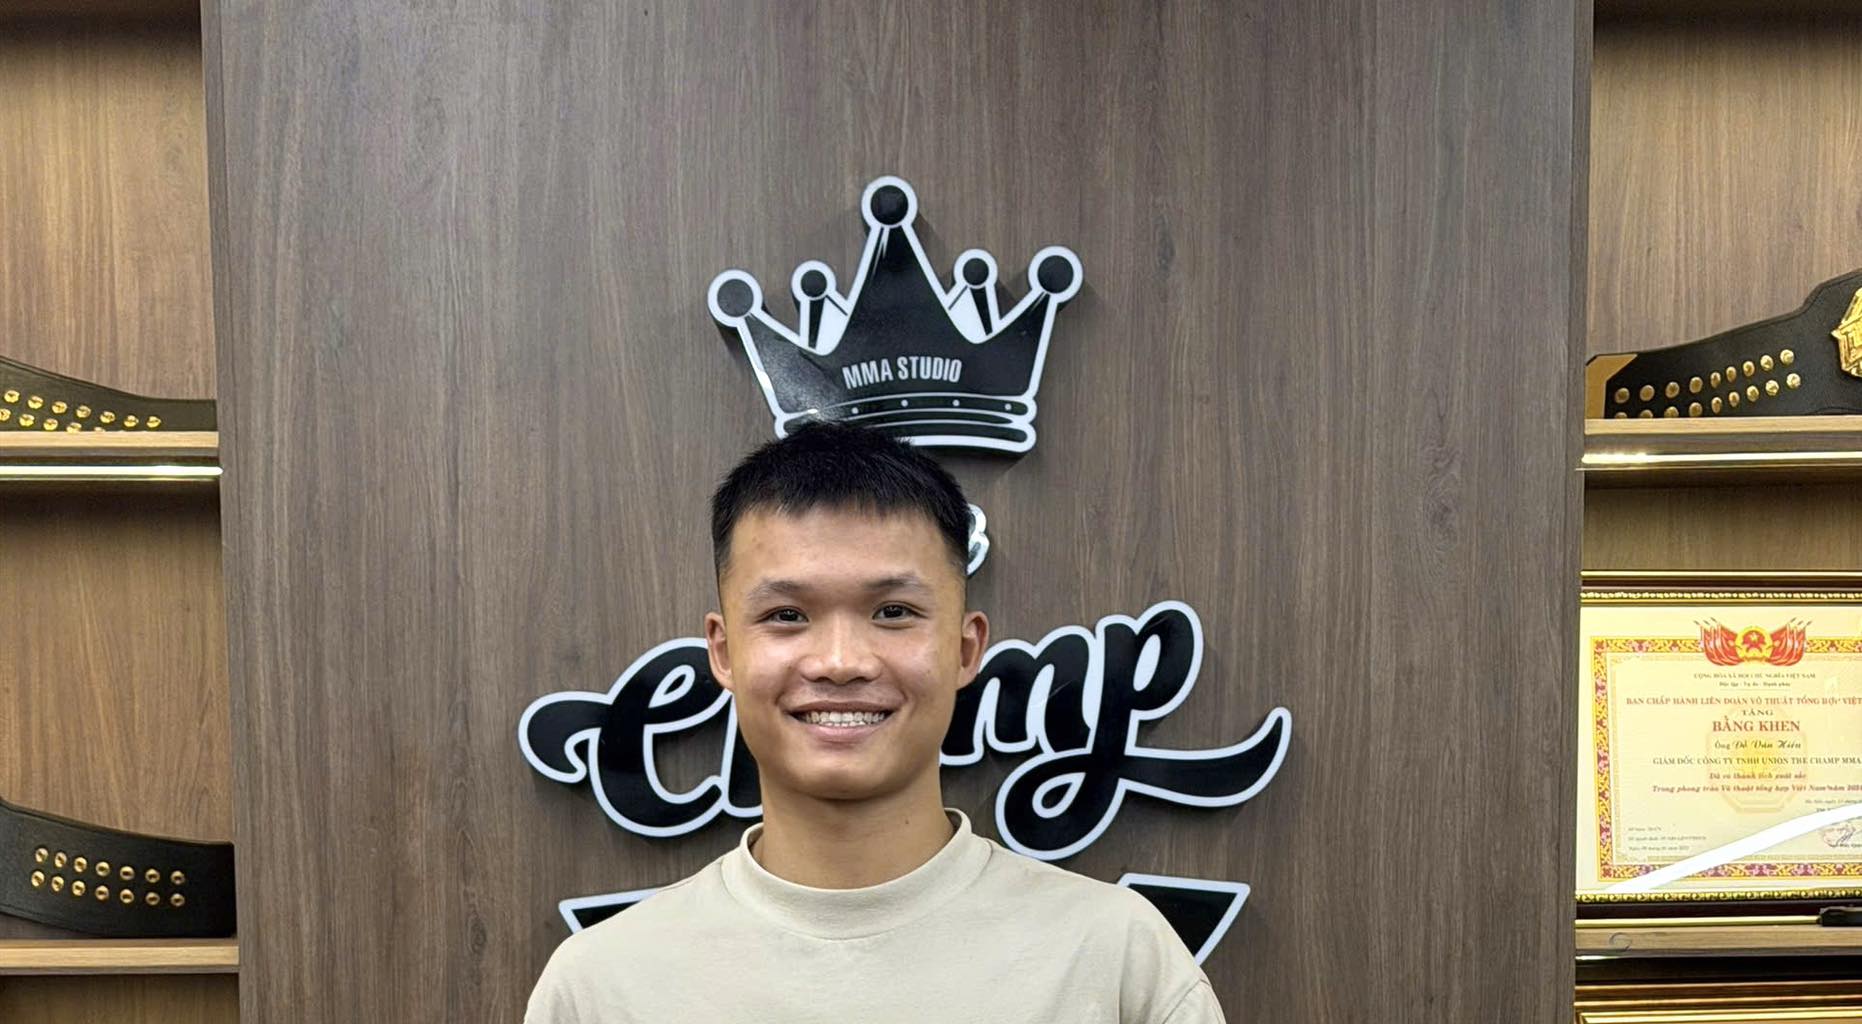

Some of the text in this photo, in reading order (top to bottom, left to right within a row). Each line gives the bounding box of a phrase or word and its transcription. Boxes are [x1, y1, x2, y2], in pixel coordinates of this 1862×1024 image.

[842, 356, 962, 390] MMA STUDIO
[1626, 697, 1644, 705] BAN
[1646, 695, 1670, 705] CHẤP
[1673, 695, 1698, 705] HÀNH
[1701, 696, 1721, 705] LIÊN
[1712, 716, 1800, 732] BẰNG KHEN
[1653, 757, 1676, 765] GIÁM
[1677, 756, 1695, 765] ĐỐC
[1697, 756, 1721, 765] CÔNG
[1723, 757, 1735, 765] TY
[1762, 757, 1789, 765] UNION
[1791, 757, 1809, 765] THE
[1809, 757, 1840, 765] CHAMP
[1842, 757, 1862, 765] MMA
